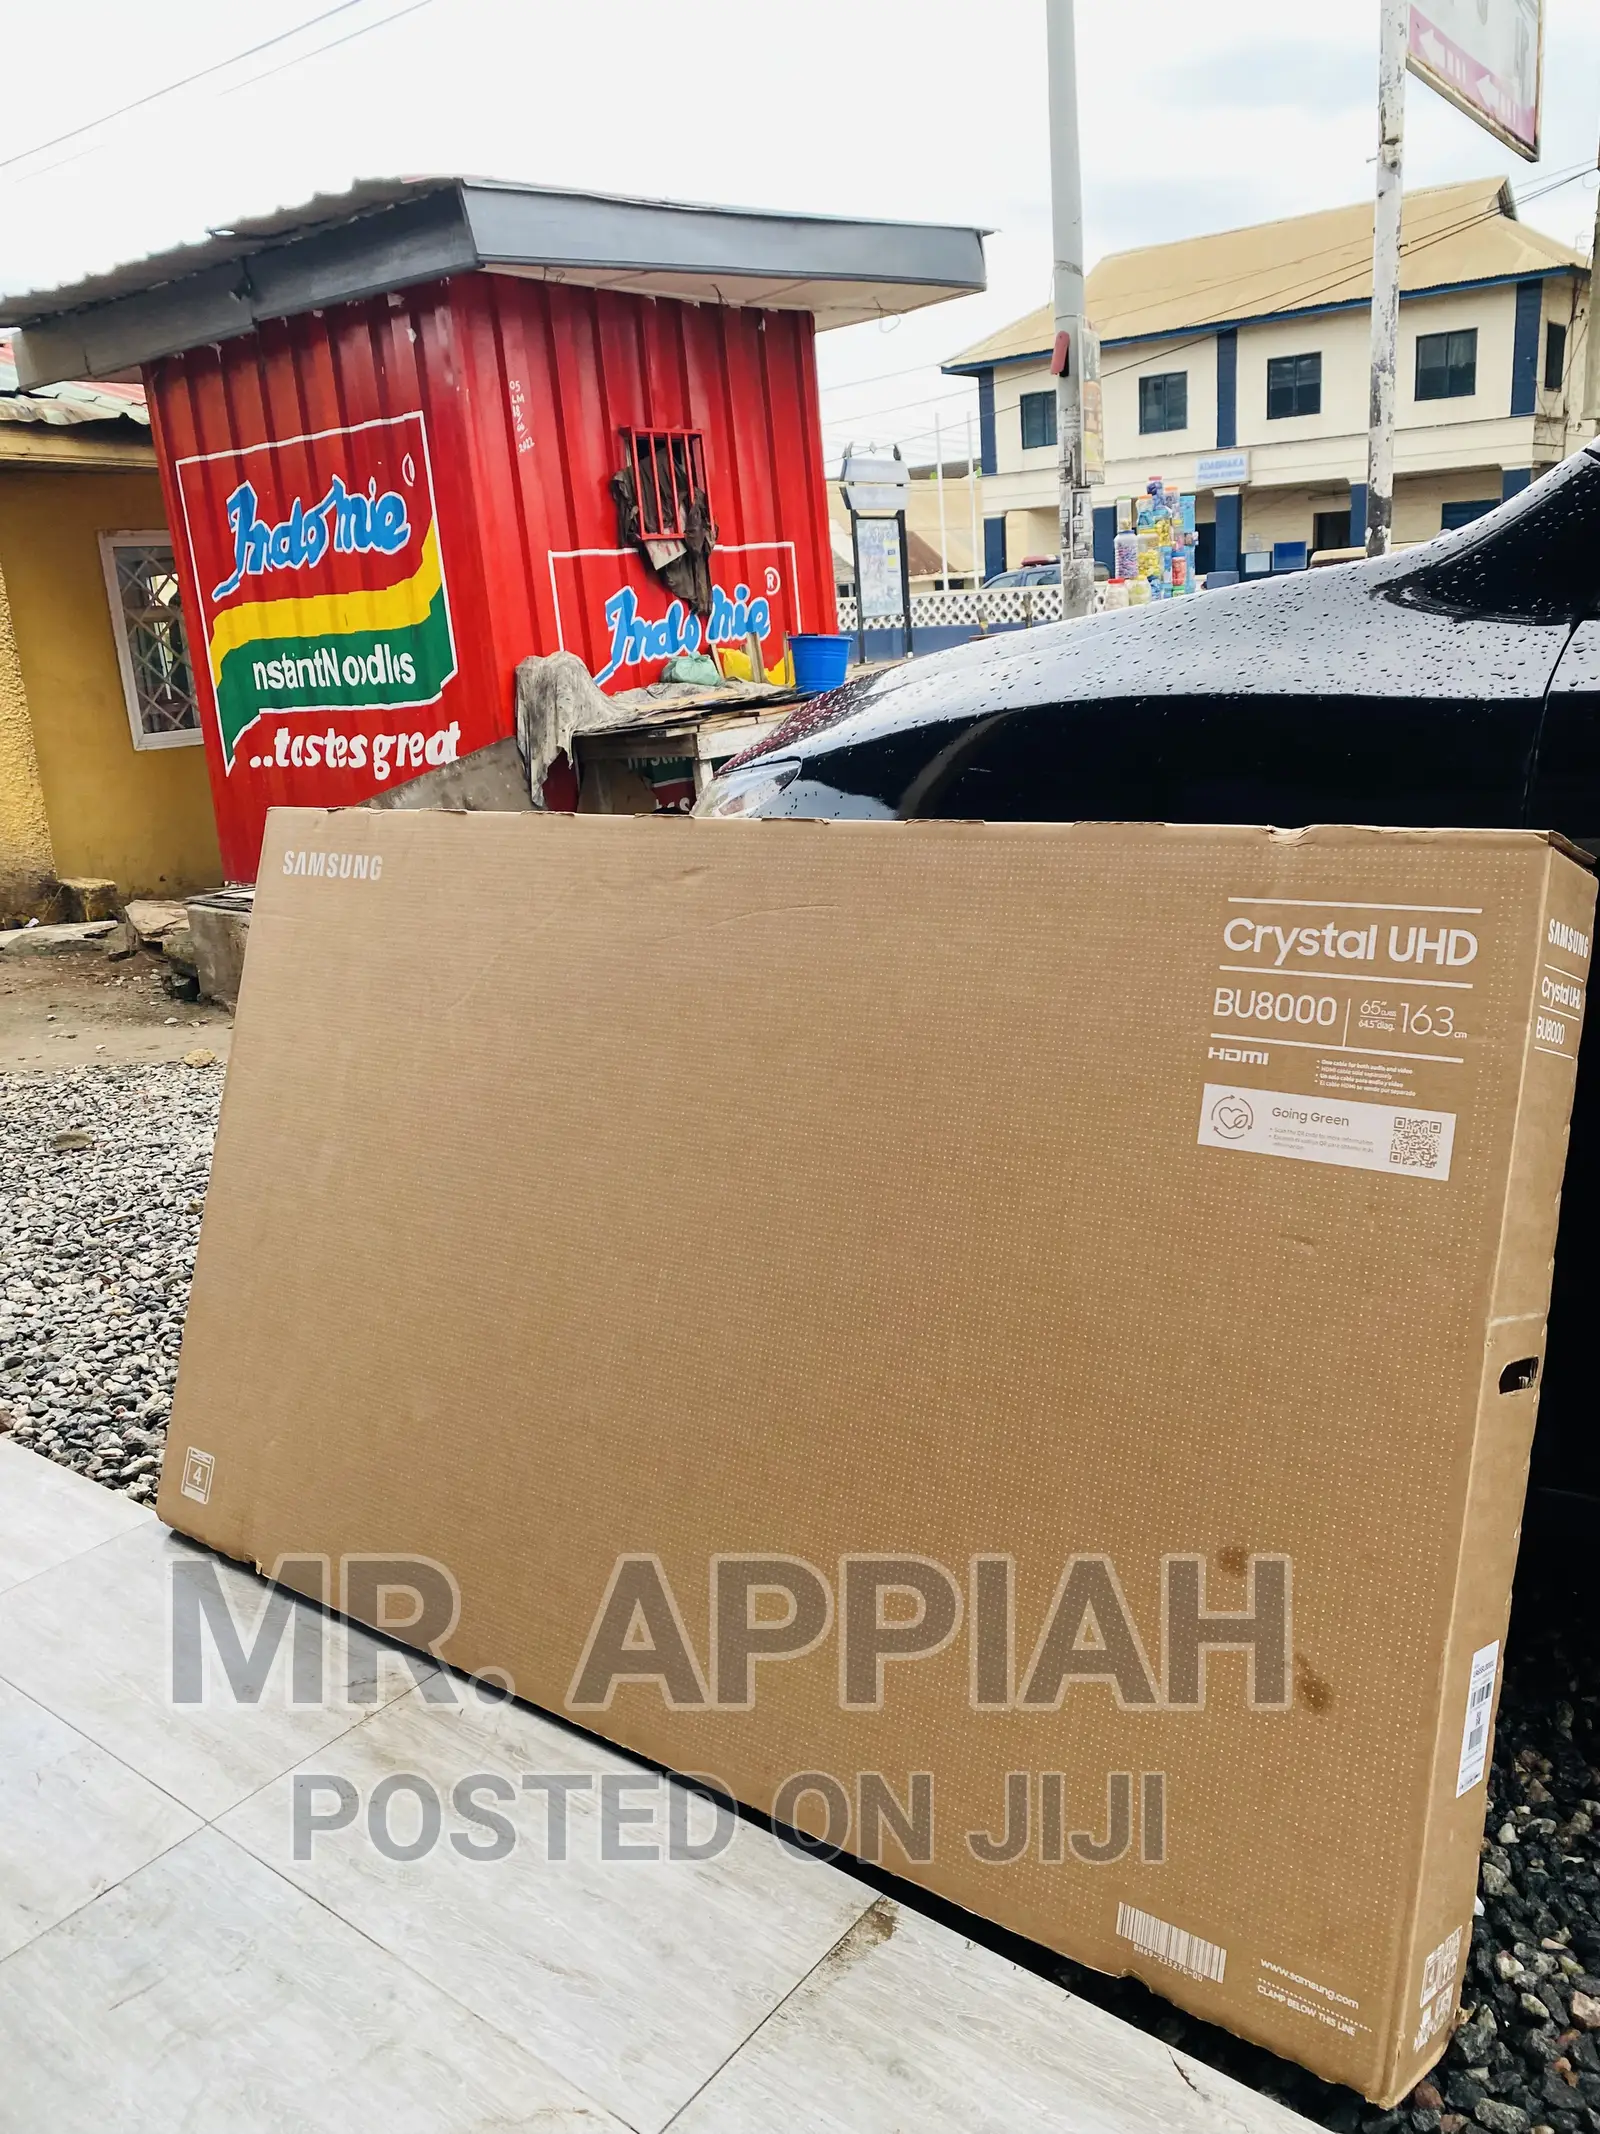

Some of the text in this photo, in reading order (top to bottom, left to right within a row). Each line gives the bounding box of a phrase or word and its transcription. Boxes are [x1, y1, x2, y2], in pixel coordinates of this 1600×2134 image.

[511, 393, 525, 404] LM
[282, 849, 383, 881] SAMSUNG
[1223, 917, 1478, 966] Crystal UHD
[1547, 918, 1589, 959] SAMSUNG
[1541, 976, 1570, 1007] Crystal
[1213, 987, 1338, 1027] BU8000
[1400, 1002, 1454, 1037] 163
[1454, 1031, 1468, 1039] cm
[1536, 1016, 1565, 1045] BU8000
[1207, 1046, 1269, 1065] HDMI
[1271, 1107, 1350, 1127] Going Green
[192, 1465, 203, 1487] 4
[1260, 1958, 1360, 2010] www.samsung.com
[1257, 1984, 1357, 2037] CLAMP BELOW THIS LINE
